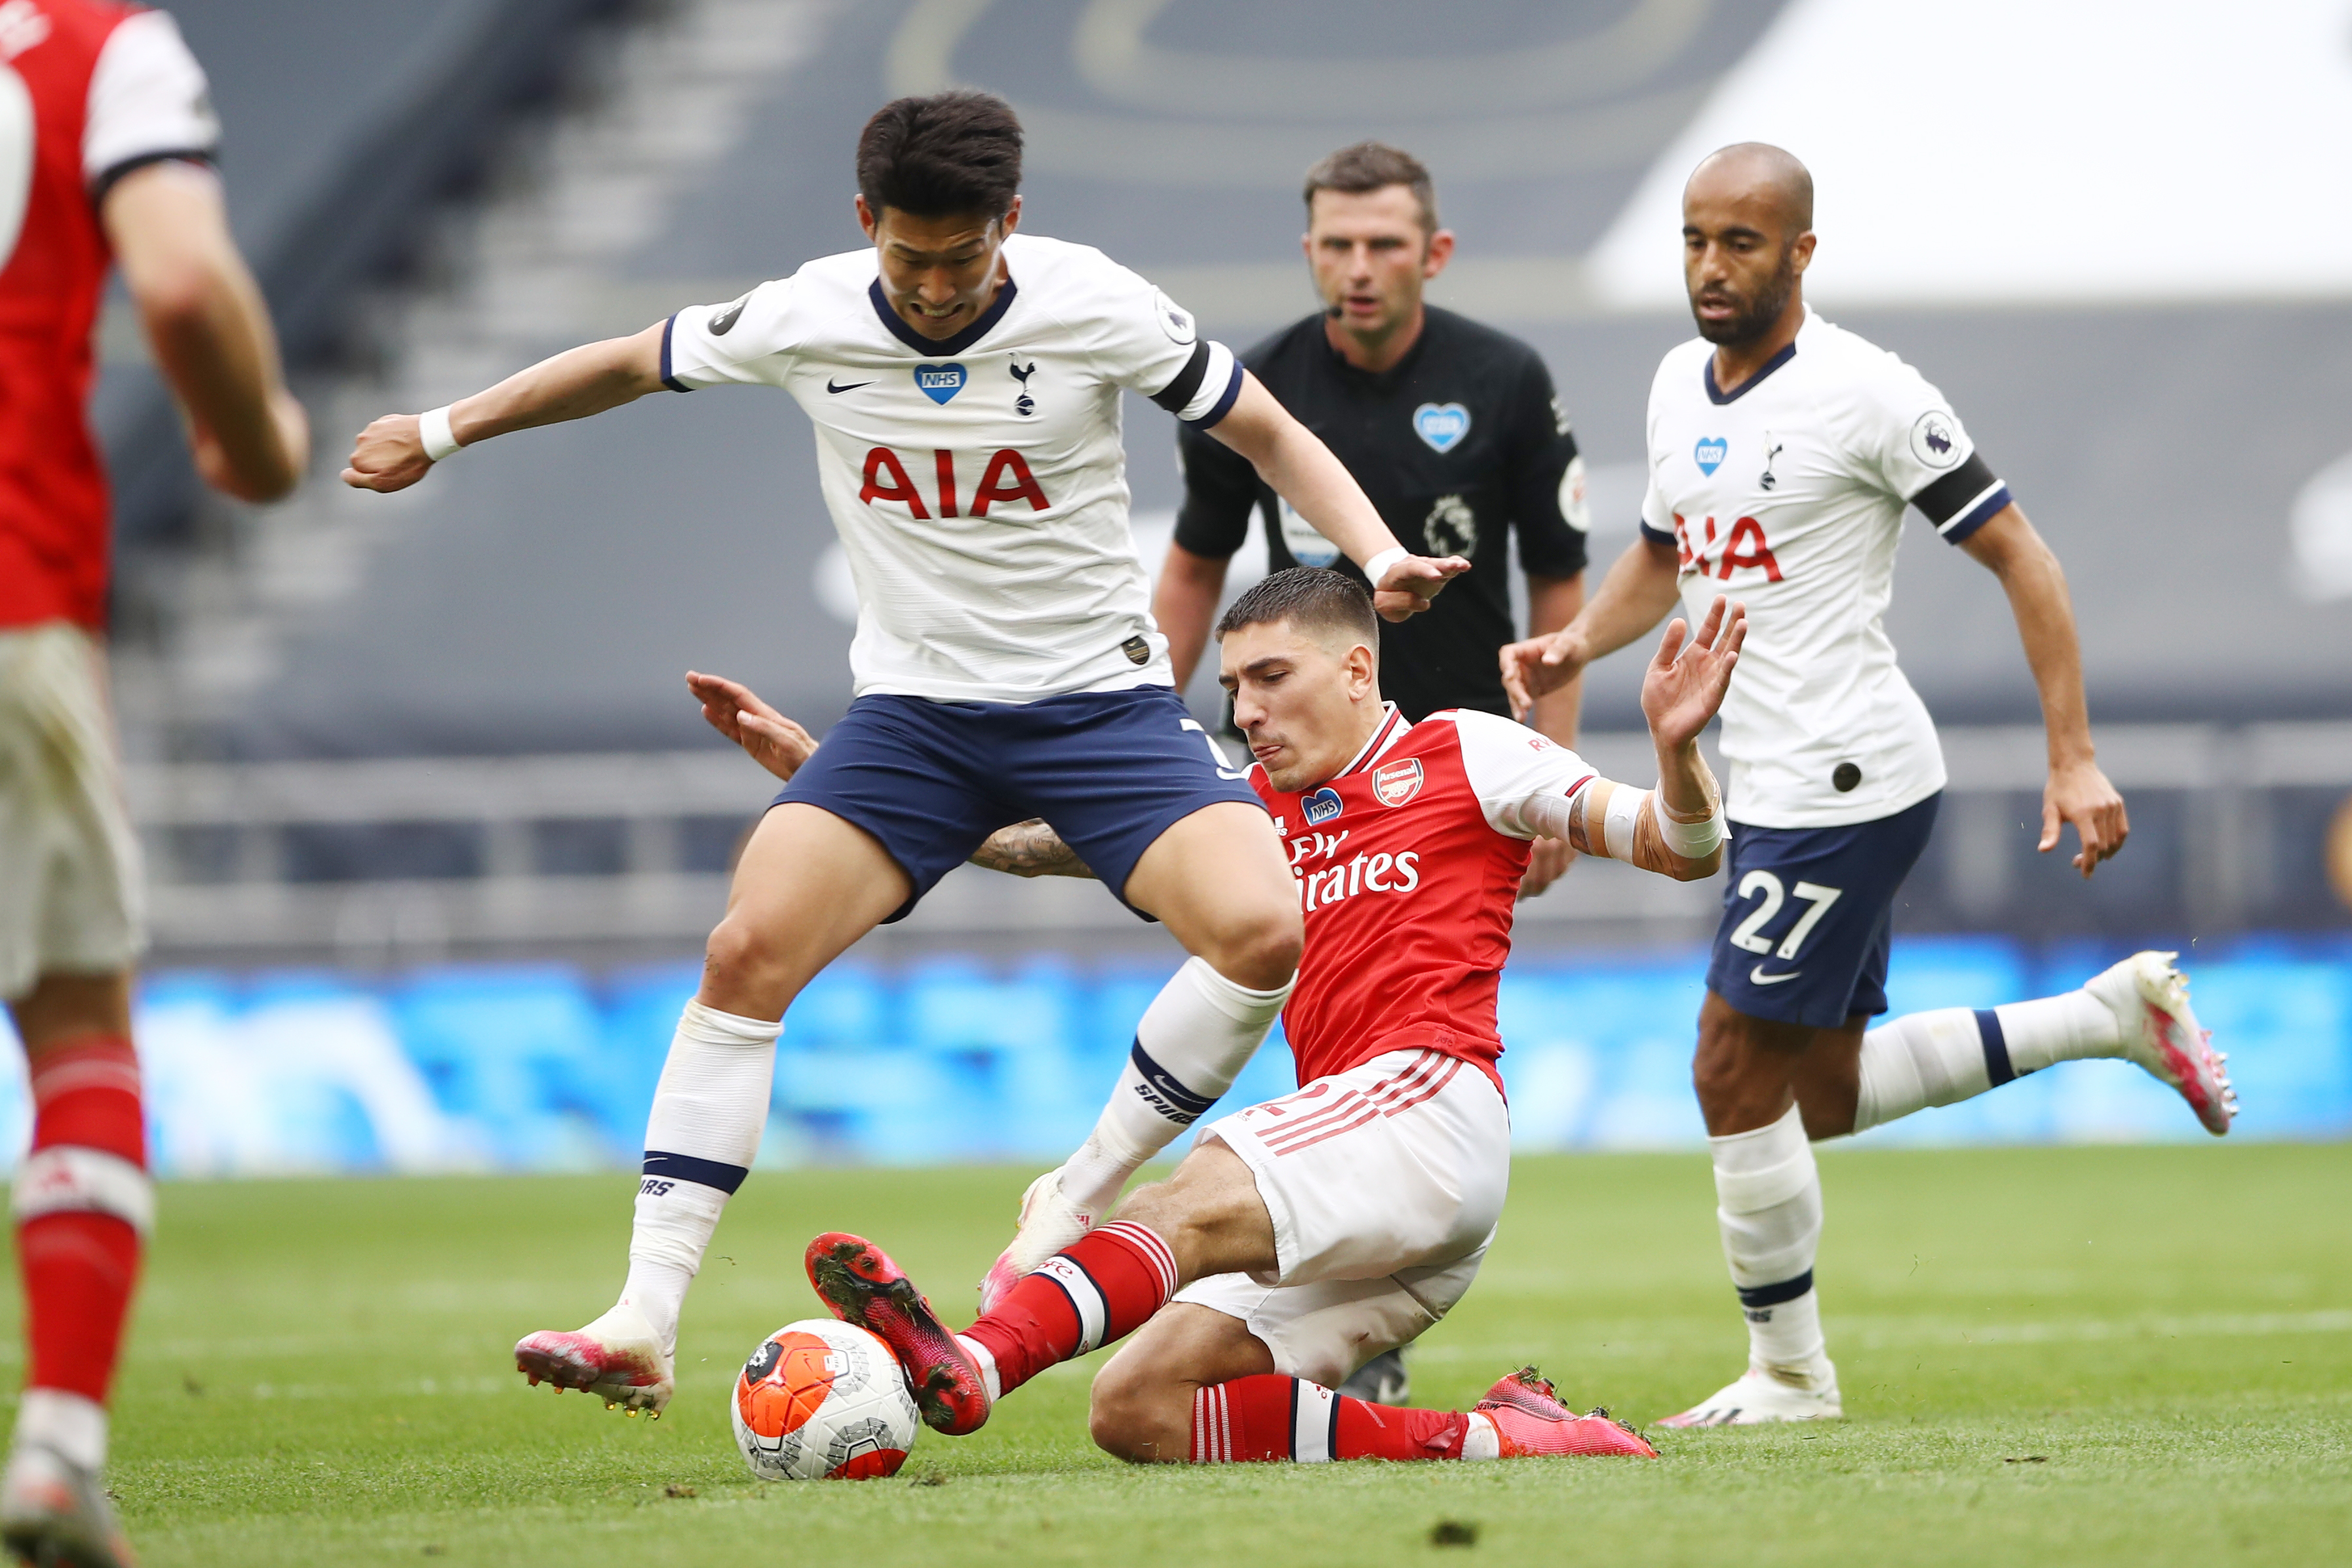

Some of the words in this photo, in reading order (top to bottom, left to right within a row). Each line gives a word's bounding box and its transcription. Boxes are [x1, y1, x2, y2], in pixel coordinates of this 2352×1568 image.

[925, 374, 957, 385] NHS
[859, 447, 1051, 519] AIA
[1379, 765, 1416, 782] Arsenal
[1313, 800, 1335, 819] NHS
[1288, 830, 1349, 865] Fly
[1294, 851, 1419, 914] irates
[1730, 869, 1842, 960] 27
[640, 1179, 675, 1197] RS
